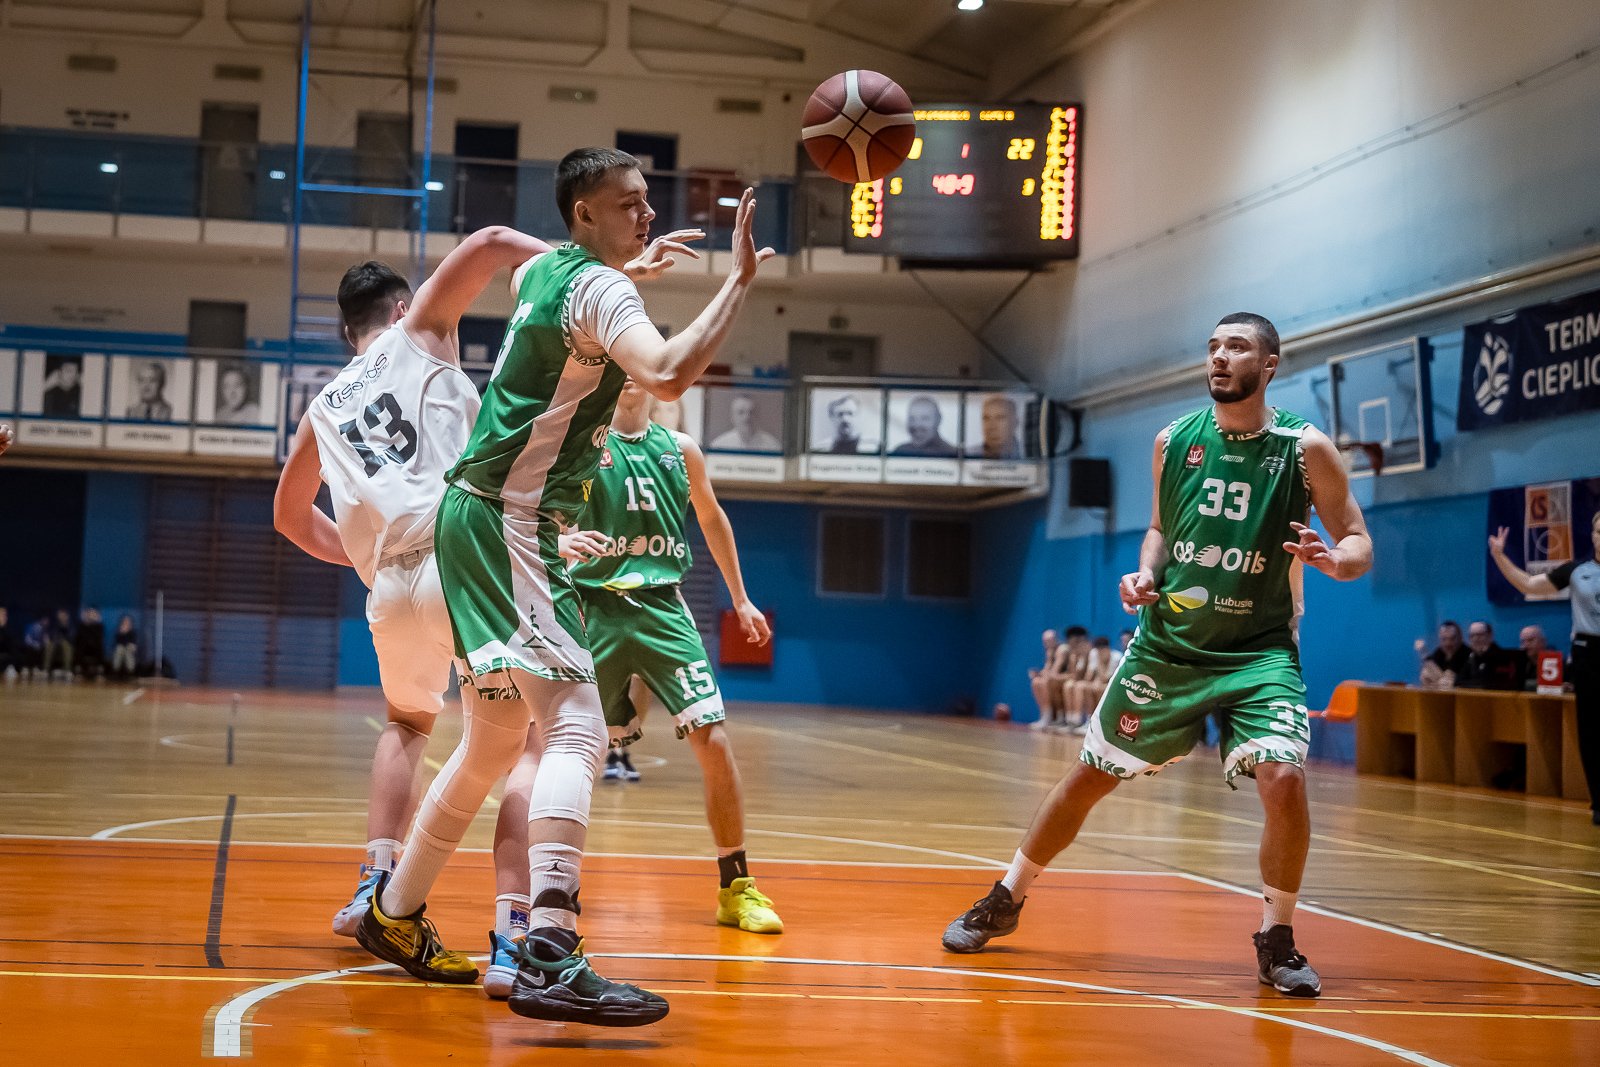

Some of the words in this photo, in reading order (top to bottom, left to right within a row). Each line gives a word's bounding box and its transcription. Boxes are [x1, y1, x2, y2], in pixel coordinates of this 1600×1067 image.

[1007, 138, 1035, 160] 22
[338, 393, 418, 479] 13
[624, 476, 657, 511] 15
[1197, 477, 1252, 521] 33
[648, 534, 686, 558] Oils
[1173, 541, 1196, 564] Q8
[1221, 547, 1267, 574] Oils
[674, 660, 716, 700] 15
[1541, 658, 1559, 681] 5
